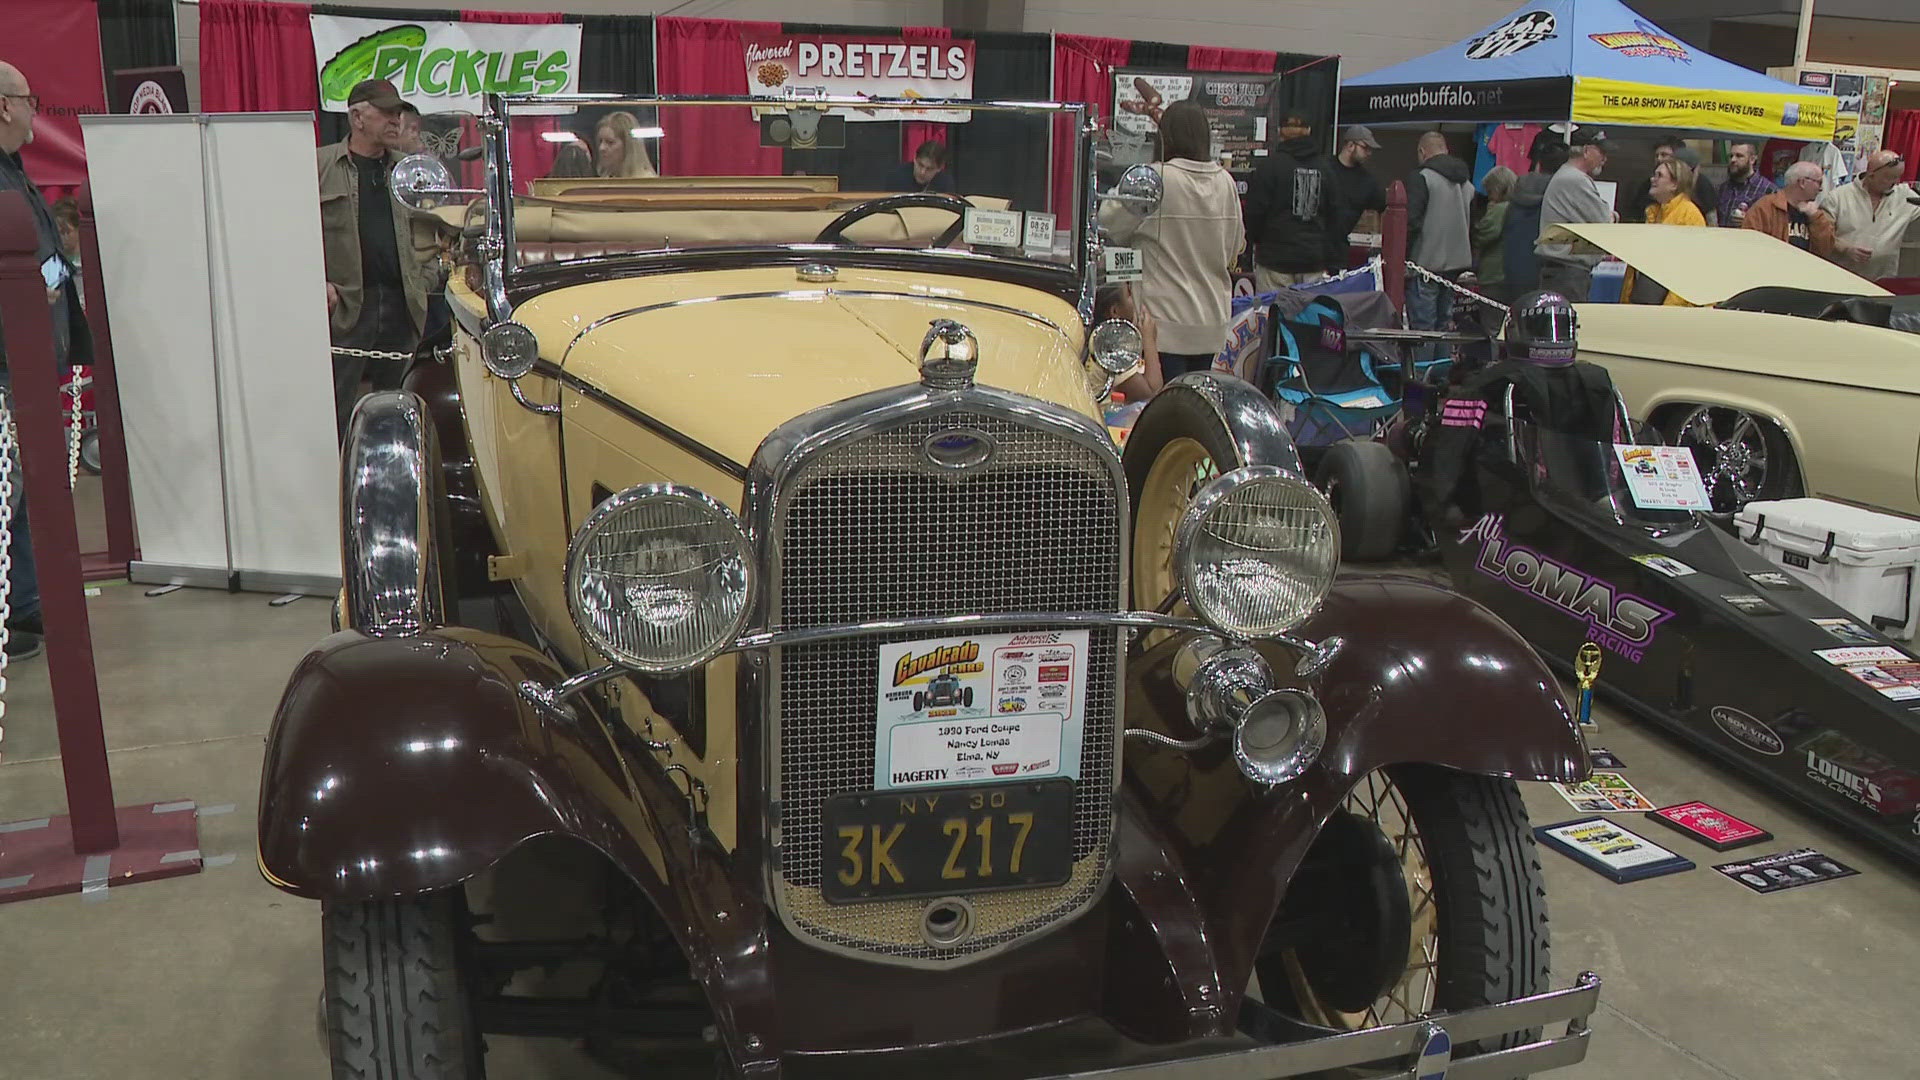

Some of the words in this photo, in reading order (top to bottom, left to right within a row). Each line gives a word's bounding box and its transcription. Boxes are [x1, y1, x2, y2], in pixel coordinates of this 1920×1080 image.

[746, 40, 792, 70] flavored
[798, 42, 967, 80] PRETZELS
[374, 45, 568, 97] PICKLES
[1369, 86, 1503, 112] manupbuffalo.net
[1602, 96, 1619, 106] THE
[1621, 96, 1640, 108] CAR
[1642, 97, 1666, 108] SHOW
[1668, 98, 1690, 109] THAT
[1691, 100, 1716, 112] SAVES
[1718, 101, 1742, 114] MEN'S
[1742, 103, 1764, 118] LIVES
[1003, 226, 1015, 238] 26
[1115, 252, 1134, 266] SNIFF
[1457, 512, 1504, 544] Ali
[1784, 554, 1808, 568] YETI
[1479, 540, 1662, 642] LOMAS
[1584, 625, 1645, 664] RACING
[965, 725, 988, 735] Ford
[991, 724, 1020, 734] Coupe
[1716, 711, 1747, 730] JASON
[947, 739, 978, 749] Nancy
[980, 738, 1010, 747] Lomas
[986, 750, 1000, 760] NY
[893, 768, 949, 783] HAGERTY
[1806, 771, 1827, 786] Car
[1808, 750, 1882, 803] LOUIE'S
[900, 796, 940, 814] NY
[970, 793, 1006, 810] 30
[836, 823, 906, 886] 3K
[941, 812, 1034, 880] 217
